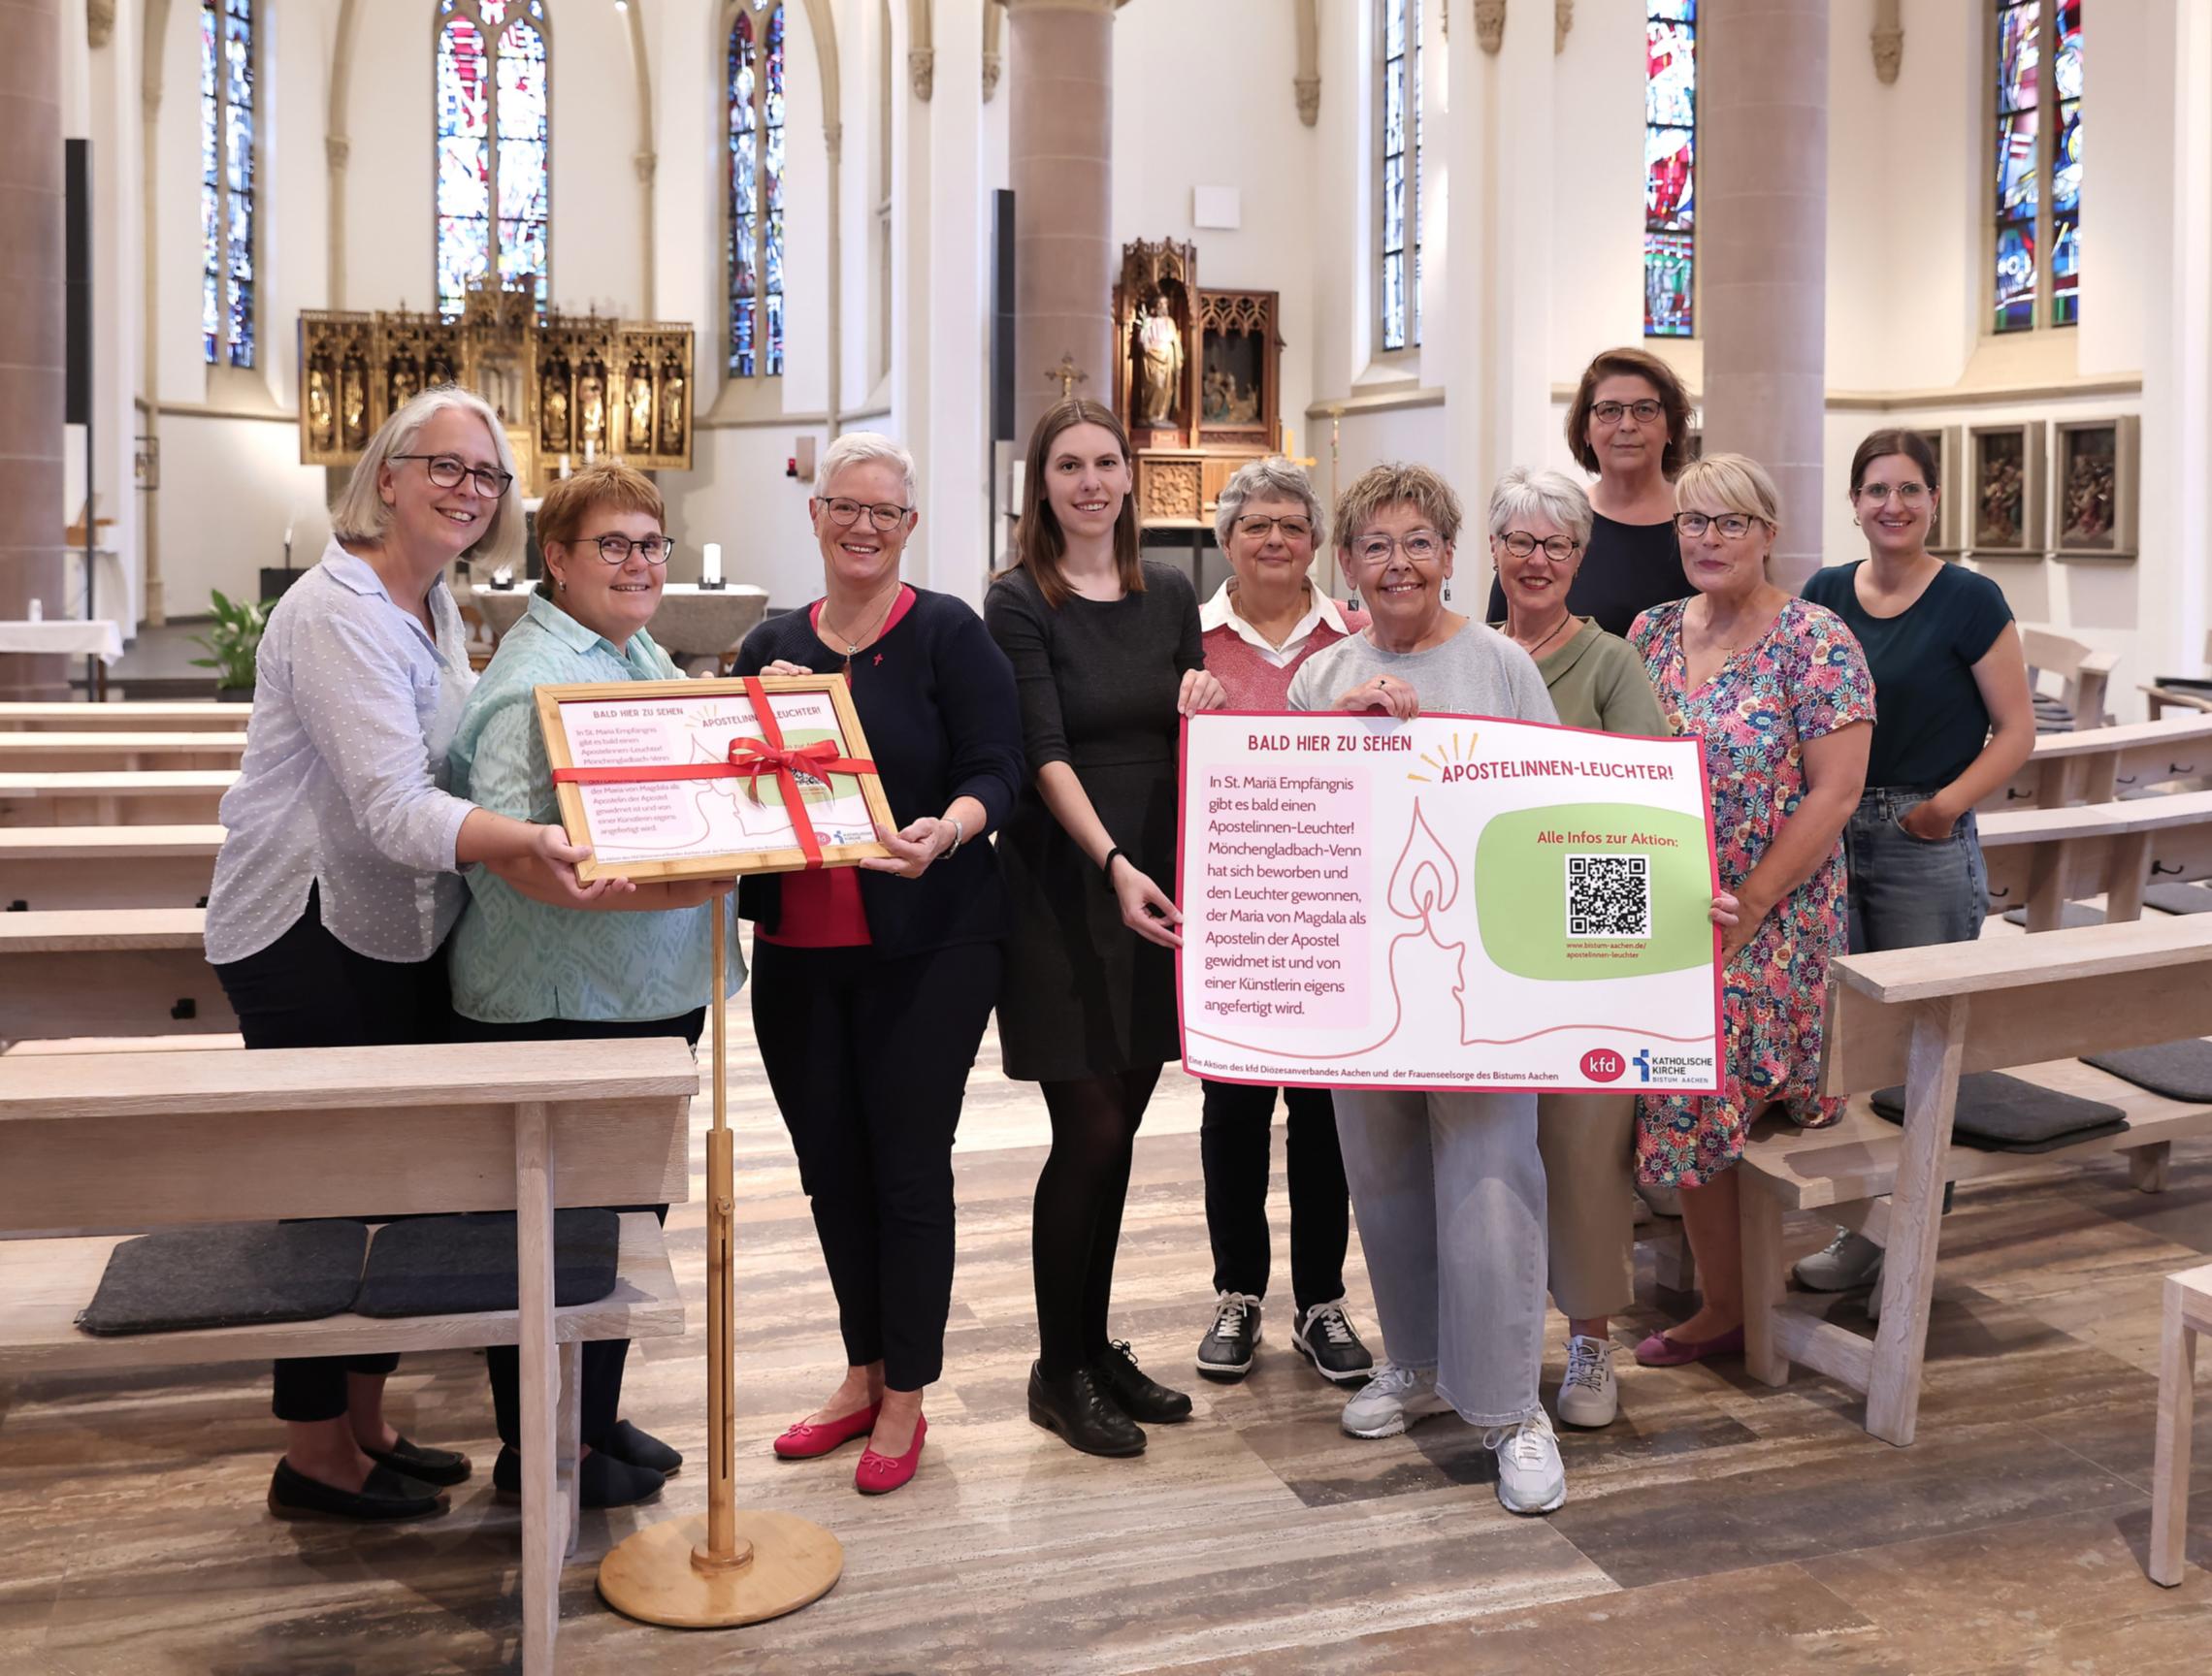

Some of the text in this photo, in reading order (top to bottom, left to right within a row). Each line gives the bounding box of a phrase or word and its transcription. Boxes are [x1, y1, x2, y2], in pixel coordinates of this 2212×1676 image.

[593, 707, 684, 719] BALD HIER ZU SEHEN
[1248, 735, 1413, 752] BALD HIER ZU SEHEN
[1442, 760, 1675, 784] APOSTELINNEN-LEUCHTER!
[1210, 776, 1353, 793] In St. Mariä Empfängnis
[1209, 797, 1316, 813] gibt es bald einen
[1209, 820, 1354, 835] Apostelinnen-Leuchter!
[1537, 831, 1678, 848] Alle Infos zur Aktion:
[1208, 842, 1362, 859] Mönchengladbach-Venn
[1207, 863, 1349, 879] hat sich beworben und
[1206, 886, 1362, 904] den Leuchter gewonnen,
[1206, 909, 1366, 927] der Maria von Magdala als
[1205, 931, 1340, 950] Apostelin der Apostel
[1566, 942, 1646, 951] www.bistum-aachen.de/
[1205, 954, 1341, 970] gewidmet ist und von
[1204, 976, 1345, 995] einer Künstlerin eigens
[1204, 999, 1305, 1017] angefertigt wird.
[1187, 1055, 1203, 1066] Eine
[1203, 1059, 1228, 1070] Aktion
[1229, 1063, 1244, 1073] des
[1246, 1064, 1258, 1073] kfd
[1341, 1068, 1371, 1078] Aachen
[1373, 1069, 1389, 1078] und
[1409, 1070, 1475, 1081] Frauenseelsorge
[1476, 1071, 1491, 1080] des
[1493, 1072, 1526, 1080] Bistums
[1528, 1071, 1559, 1081] Aachen
[1589, 1056, 1615, 1073] kfd
[1652, 1057, 1712, 1066] KATHOLISCHE
